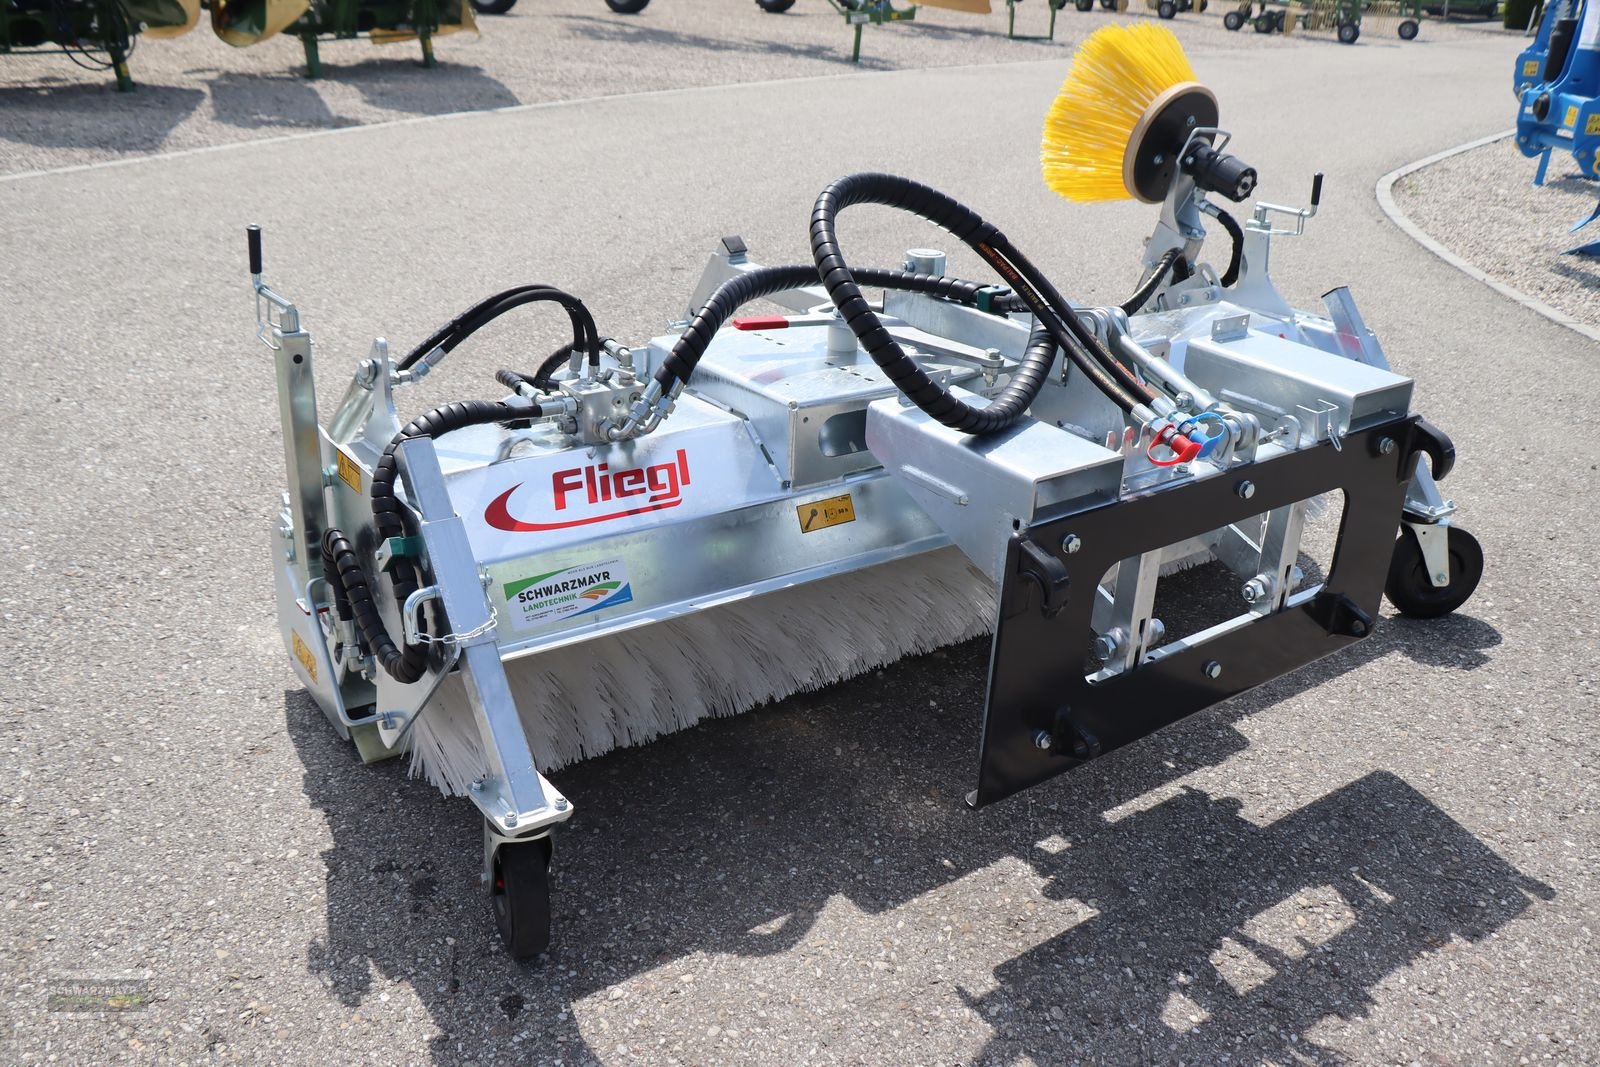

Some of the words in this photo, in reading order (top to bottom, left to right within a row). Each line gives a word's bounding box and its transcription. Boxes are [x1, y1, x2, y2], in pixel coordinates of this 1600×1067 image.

[552, 448, 690, 511] Fliegl
[518, 571, 611, 603] SCHWARZMAYR
[523, 593, 577, 612] LANDTECHNIK
